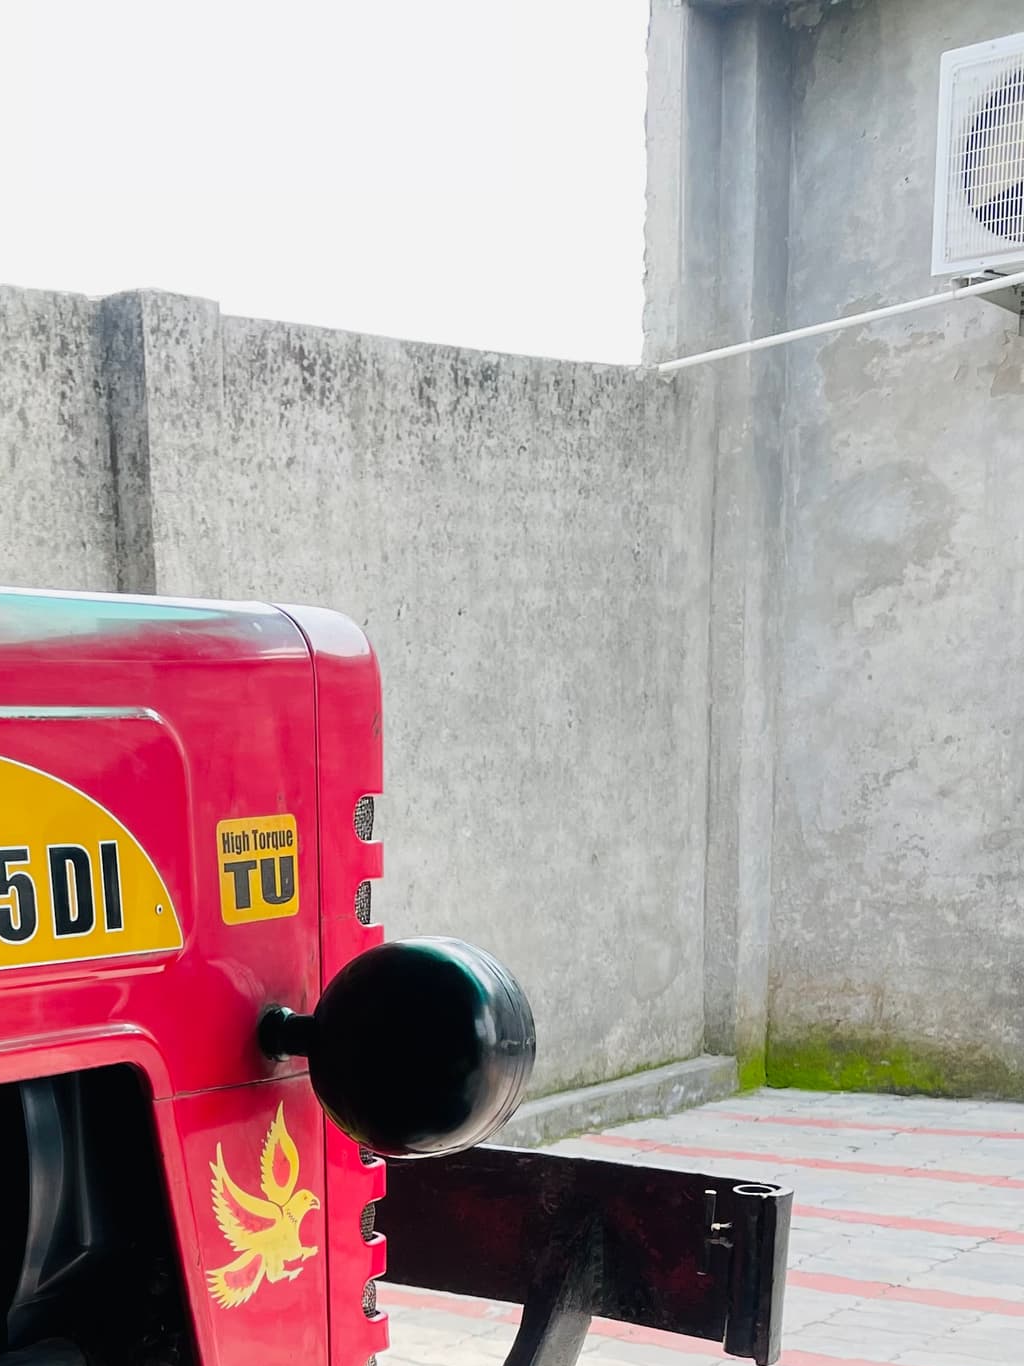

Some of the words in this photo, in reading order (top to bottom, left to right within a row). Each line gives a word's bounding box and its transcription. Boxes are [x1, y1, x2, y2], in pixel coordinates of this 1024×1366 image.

[222, 831, 250, 855] High
[252, 829, 293, 850] Torque
[47, 840, 124, 940] DI
[223, 855, 296, 910] TU
